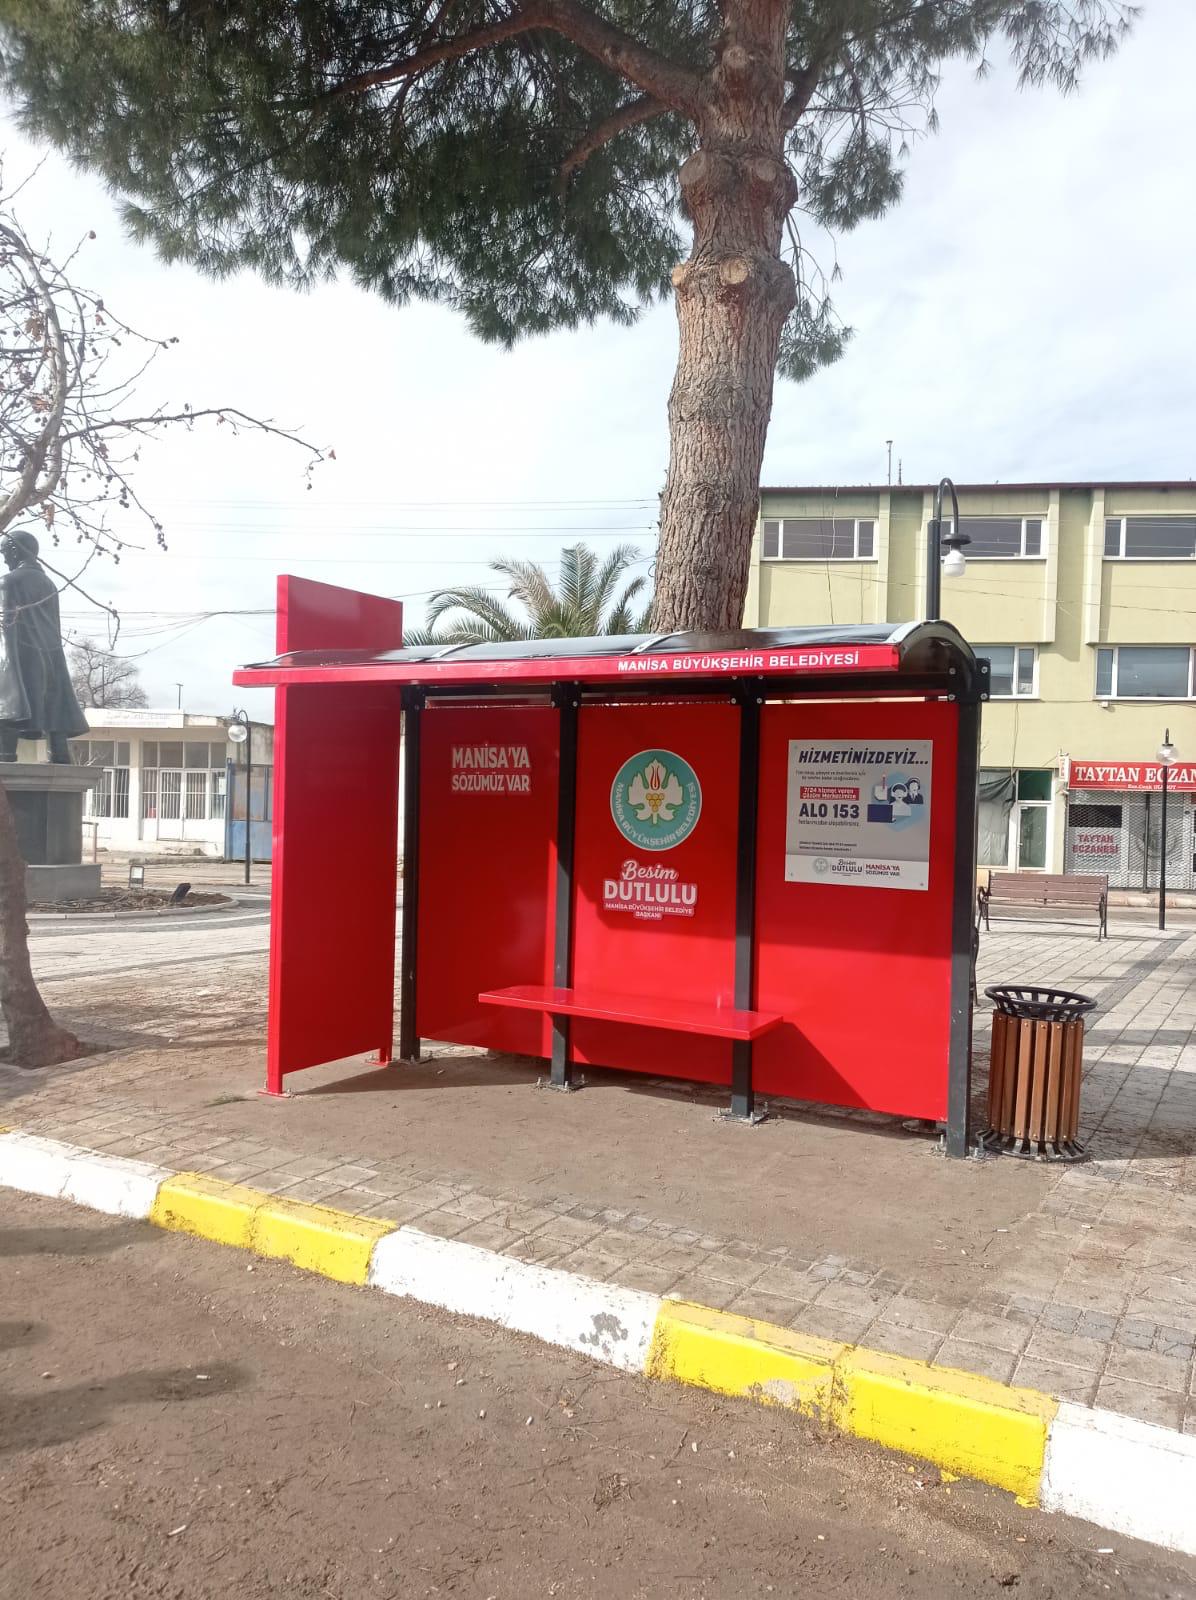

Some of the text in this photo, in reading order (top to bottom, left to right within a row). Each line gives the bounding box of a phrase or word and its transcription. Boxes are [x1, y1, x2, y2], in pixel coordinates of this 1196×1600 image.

[618, 650, 859, 671] MANİSA BÜYÜKŞEHİR BELEDİYESİ
[452, 744, 530, 768] MANİSA'YA
[798, 747, 929, 764] HİZMETİNİZDEYİZ...
[452, 772, 530, 792] SÖZÜMÜZ VAR
[1075, 766, 1140, 782] TAYTAN
[799, 802, 860, 819] ALO 153
[1078, 834, 1114, 843] TAYTAN
[622, 860, 679, 880] Besim
[604, 880, 698, 905] DUTLULU
